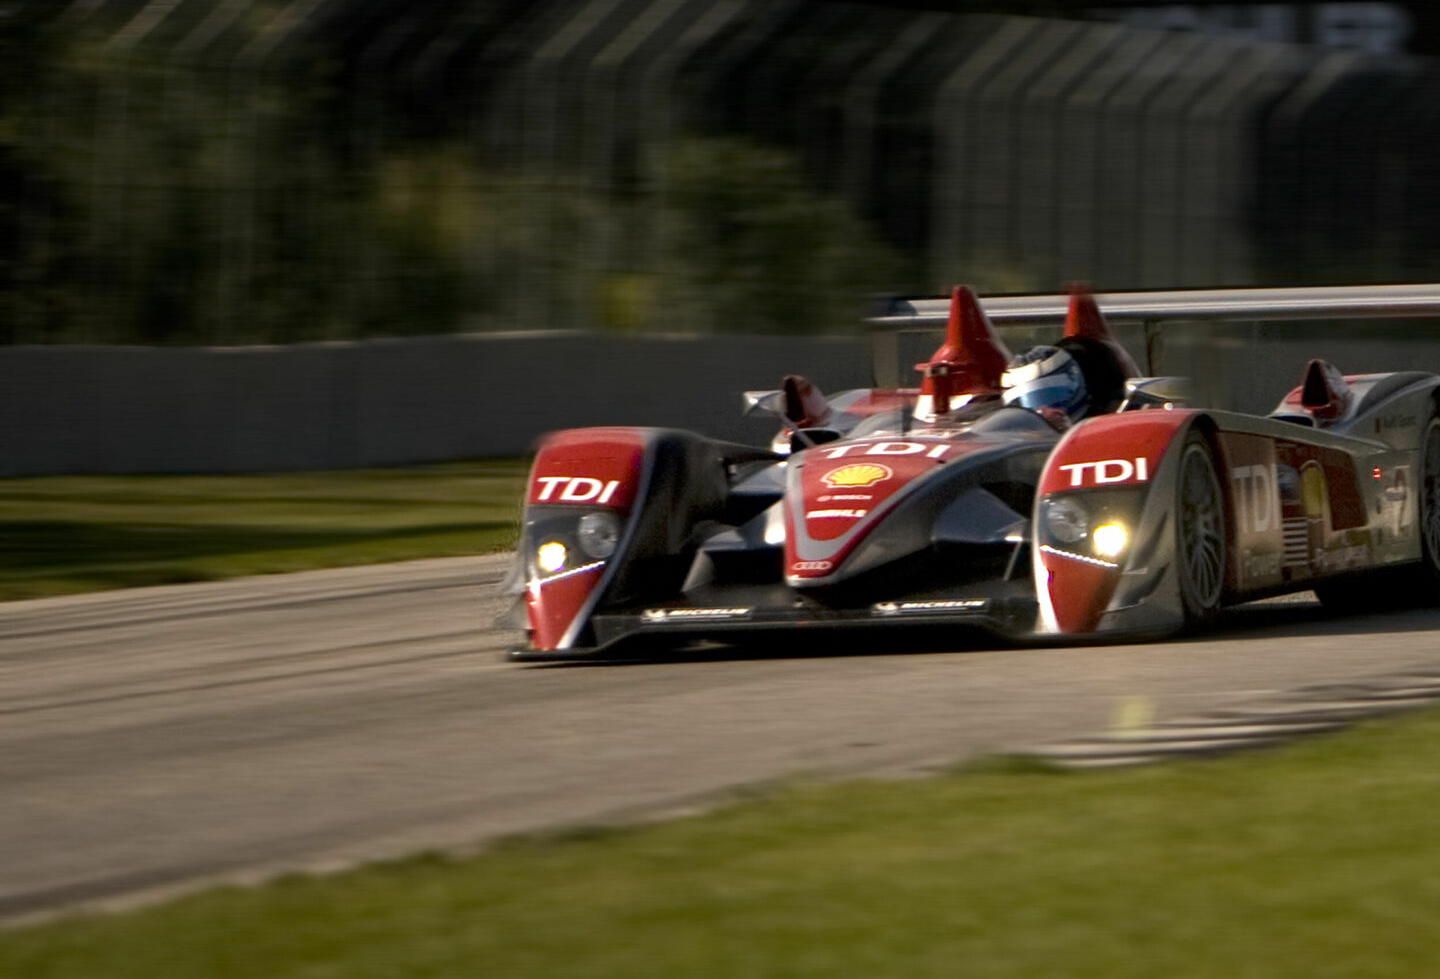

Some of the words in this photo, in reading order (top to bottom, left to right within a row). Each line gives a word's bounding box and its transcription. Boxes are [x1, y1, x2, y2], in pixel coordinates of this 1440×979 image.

[820, 442, 951, 459] TDI
[1059, 457, 1147, 486] TDI
[537, 476, 620, 503] TDI
[1232, 463, 1279, 534] TDI
[668, 608, 750, 616] MICHELIN
[901, 600, 985, 609] MICHELIN
